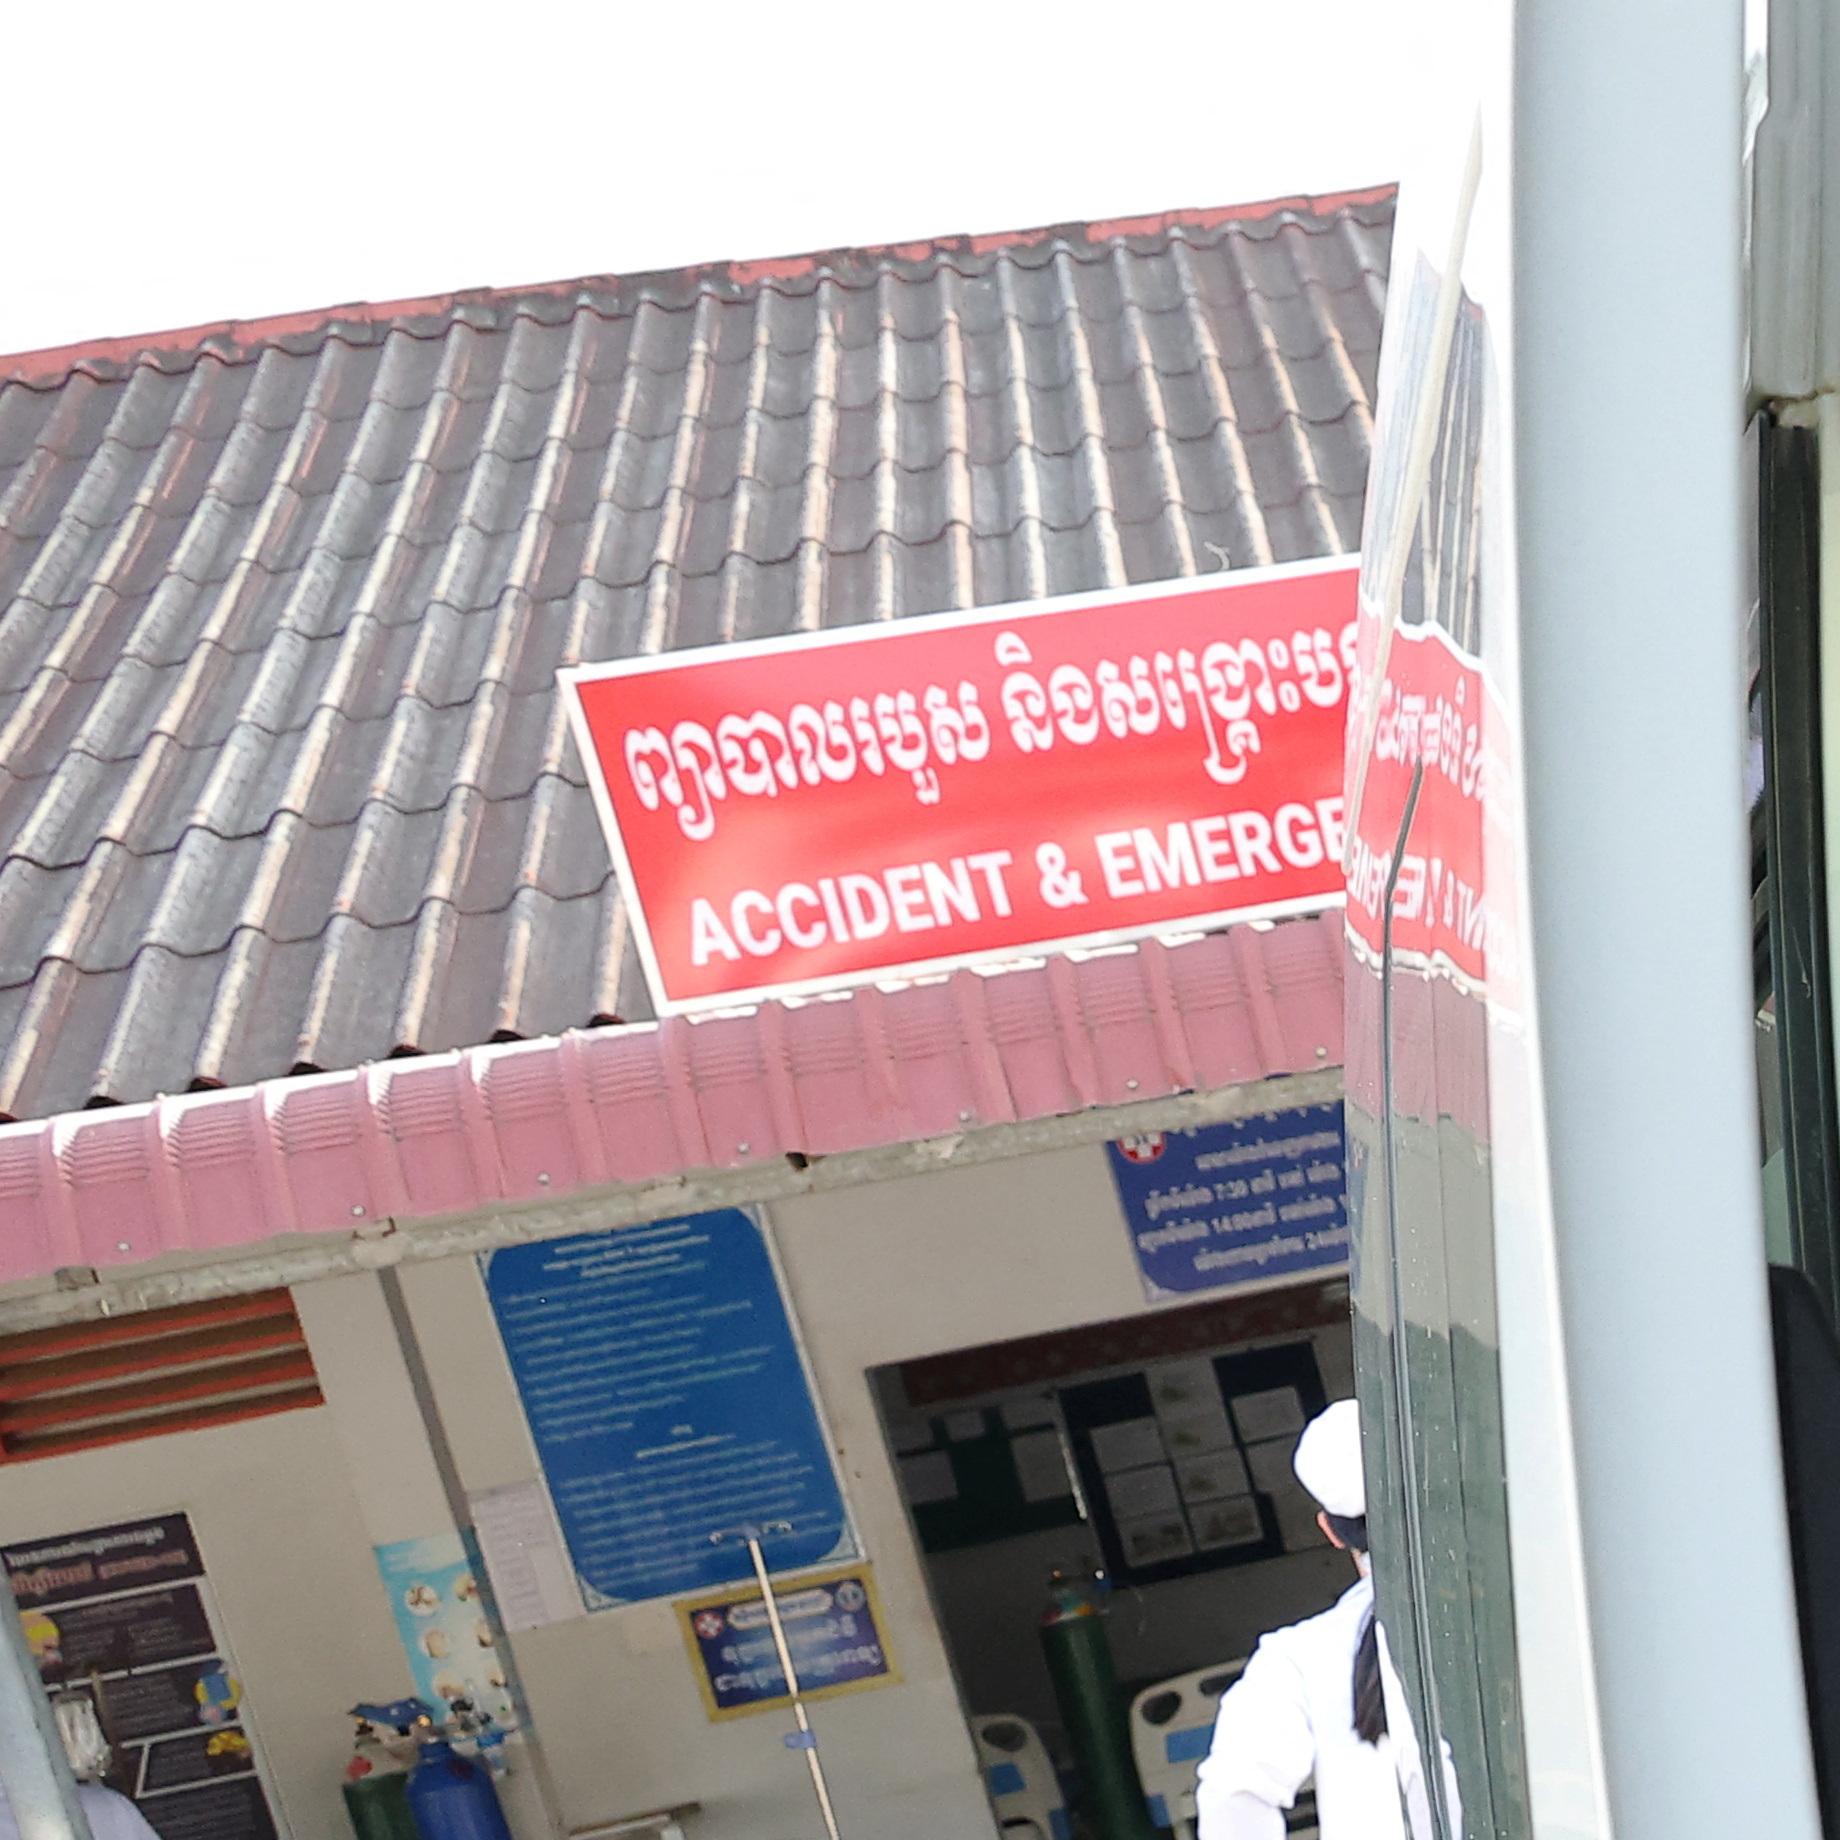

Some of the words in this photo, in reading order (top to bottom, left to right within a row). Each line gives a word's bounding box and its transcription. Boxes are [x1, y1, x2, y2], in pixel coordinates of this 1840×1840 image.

[690, 851, 1014, 967] ACCIDENT
[1036, 841, 1090, 905] &
[1094, 796, 1345, 900] EMERGE
